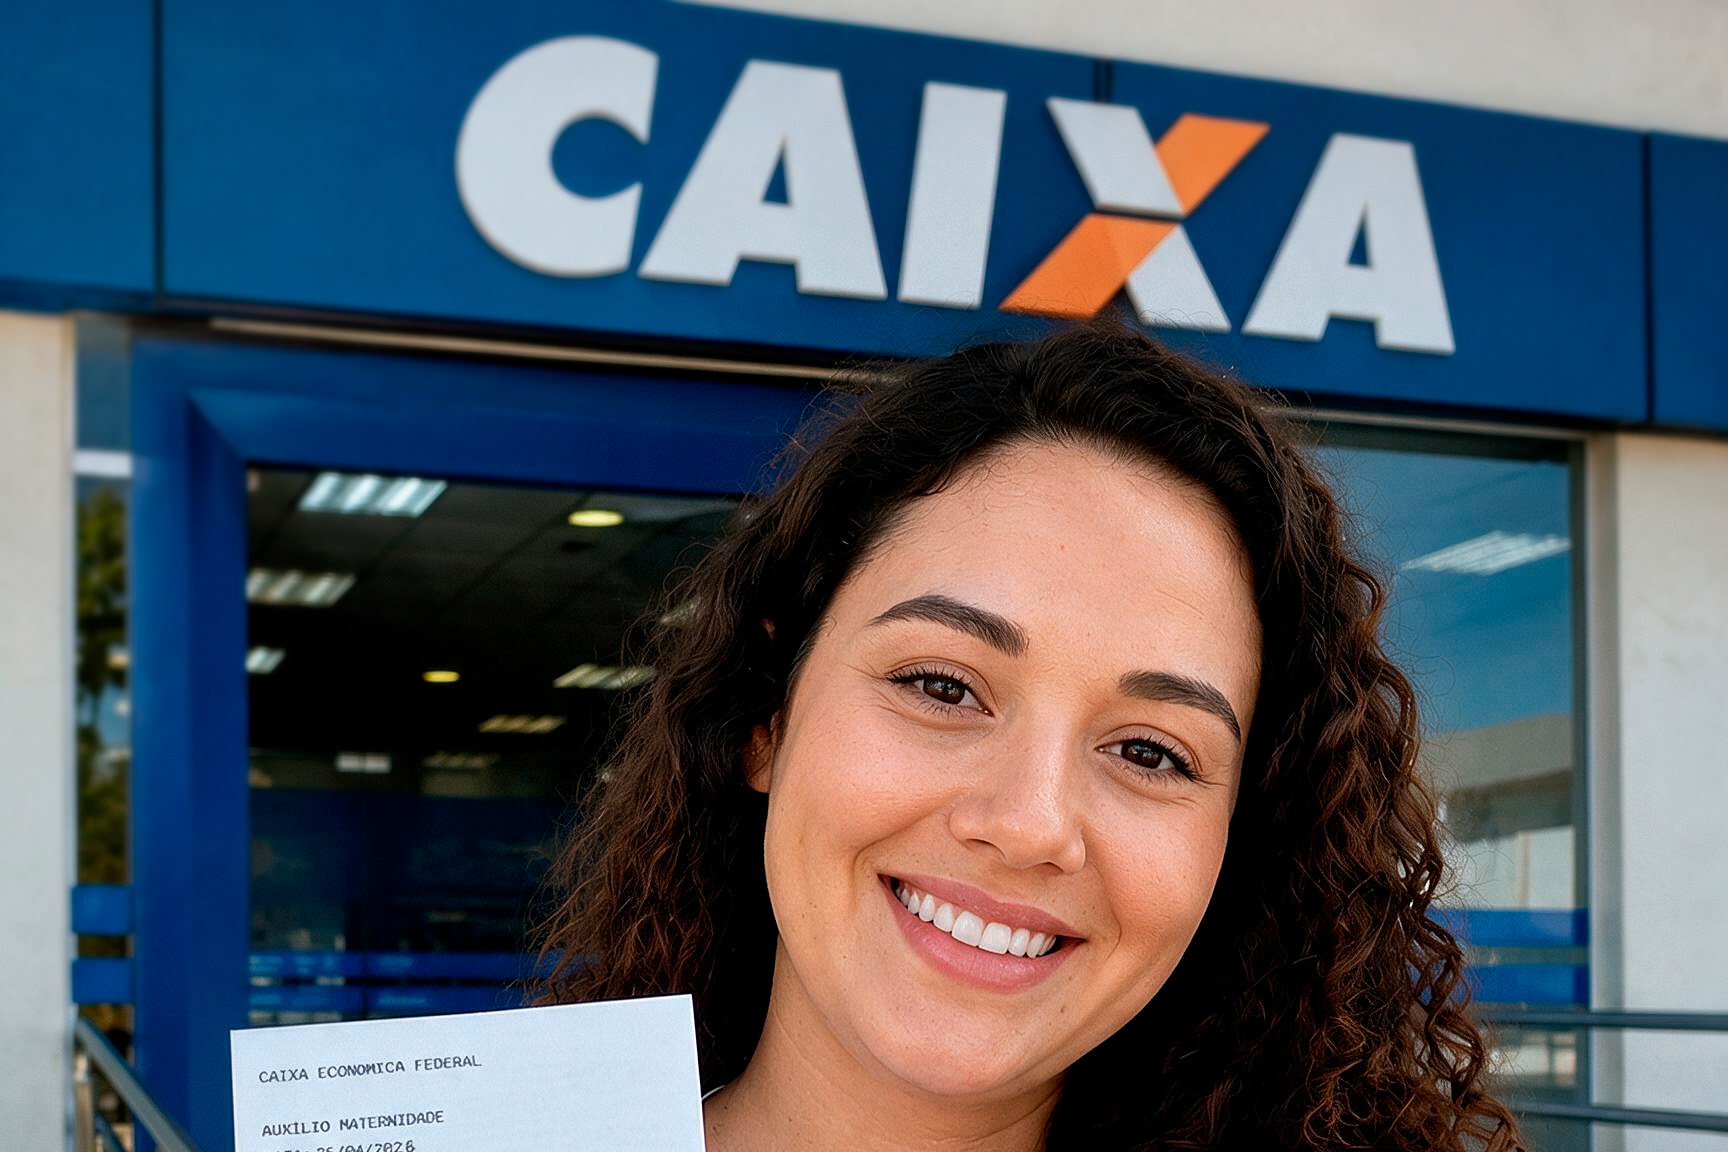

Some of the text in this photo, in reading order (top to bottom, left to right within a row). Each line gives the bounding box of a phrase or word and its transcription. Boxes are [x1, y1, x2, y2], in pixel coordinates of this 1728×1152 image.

[454, 35, 1456, 356] CAIXA
[257, 1054, 483, 1084] CAIXA ECONOMICA FEDERAL
[338, 1109, 445, 1132] MATERNIDADE
